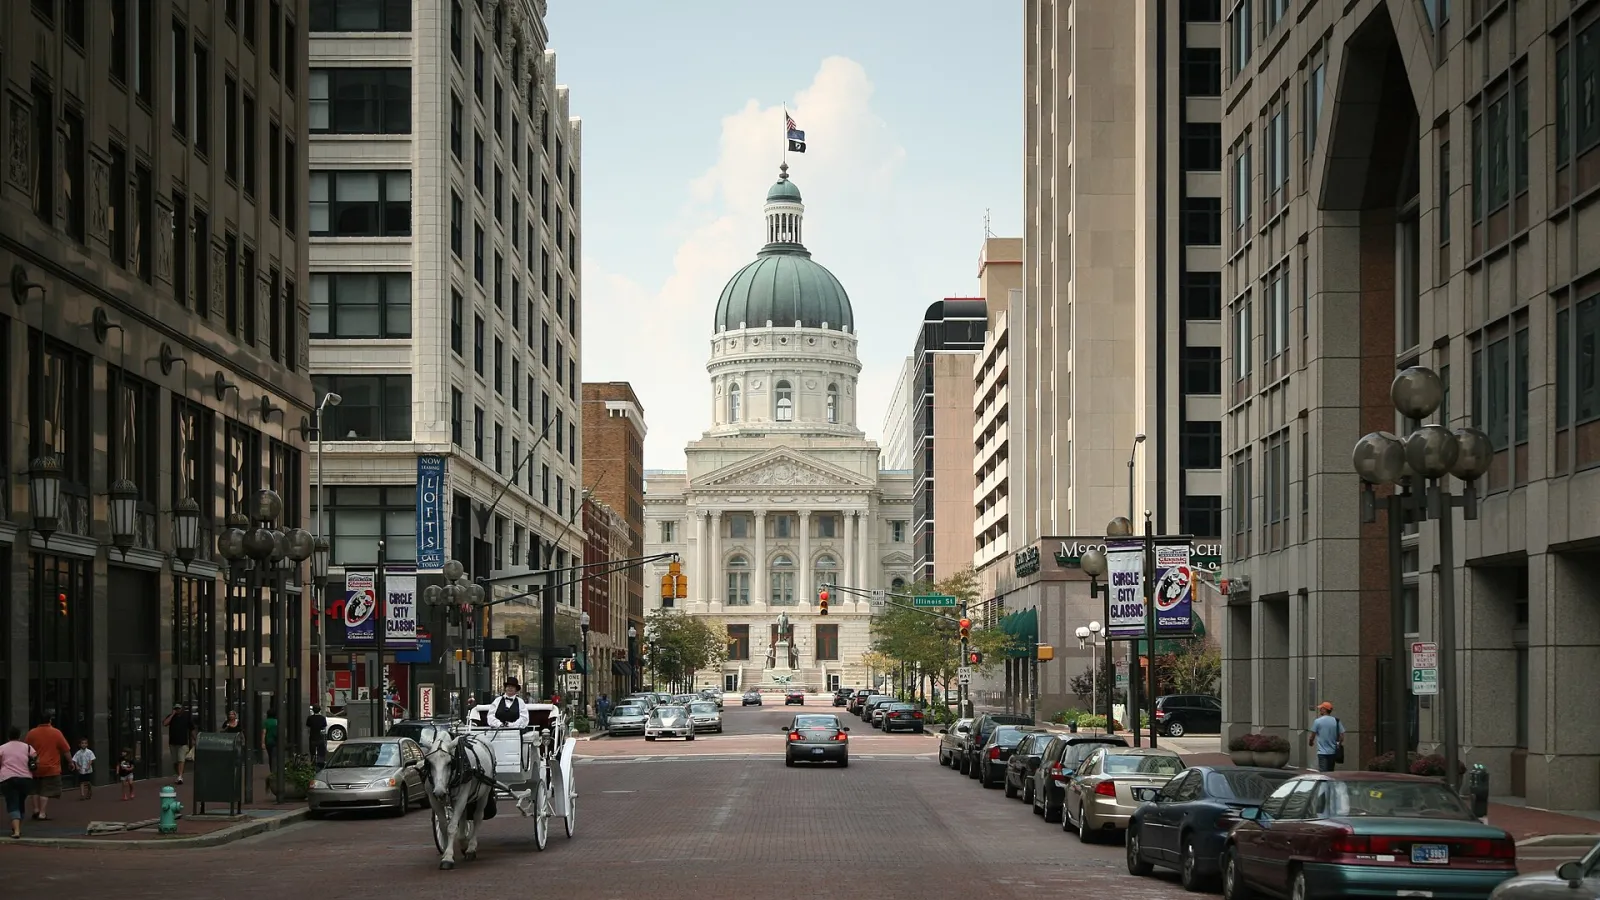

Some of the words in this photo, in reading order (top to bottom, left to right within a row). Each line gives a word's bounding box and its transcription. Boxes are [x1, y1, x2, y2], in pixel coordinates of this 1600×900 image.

[421, 457, 440, 465] NOW
[424, 478, 436, 548] LOFTS
[421, 554, 440, 562] CALL
[1112, 572, 1139, 586] CIRCLE
[389, 593, 412, 604] CIRCLE
[1117, 588, 1136, 602] CITY
[393, 606, 409, 618] CITY
[1110, 603, 1144, 618] CLASSIC
[387, 620, 415, 632] CLASSIC
[1414, 671, 1421, 681] 2
